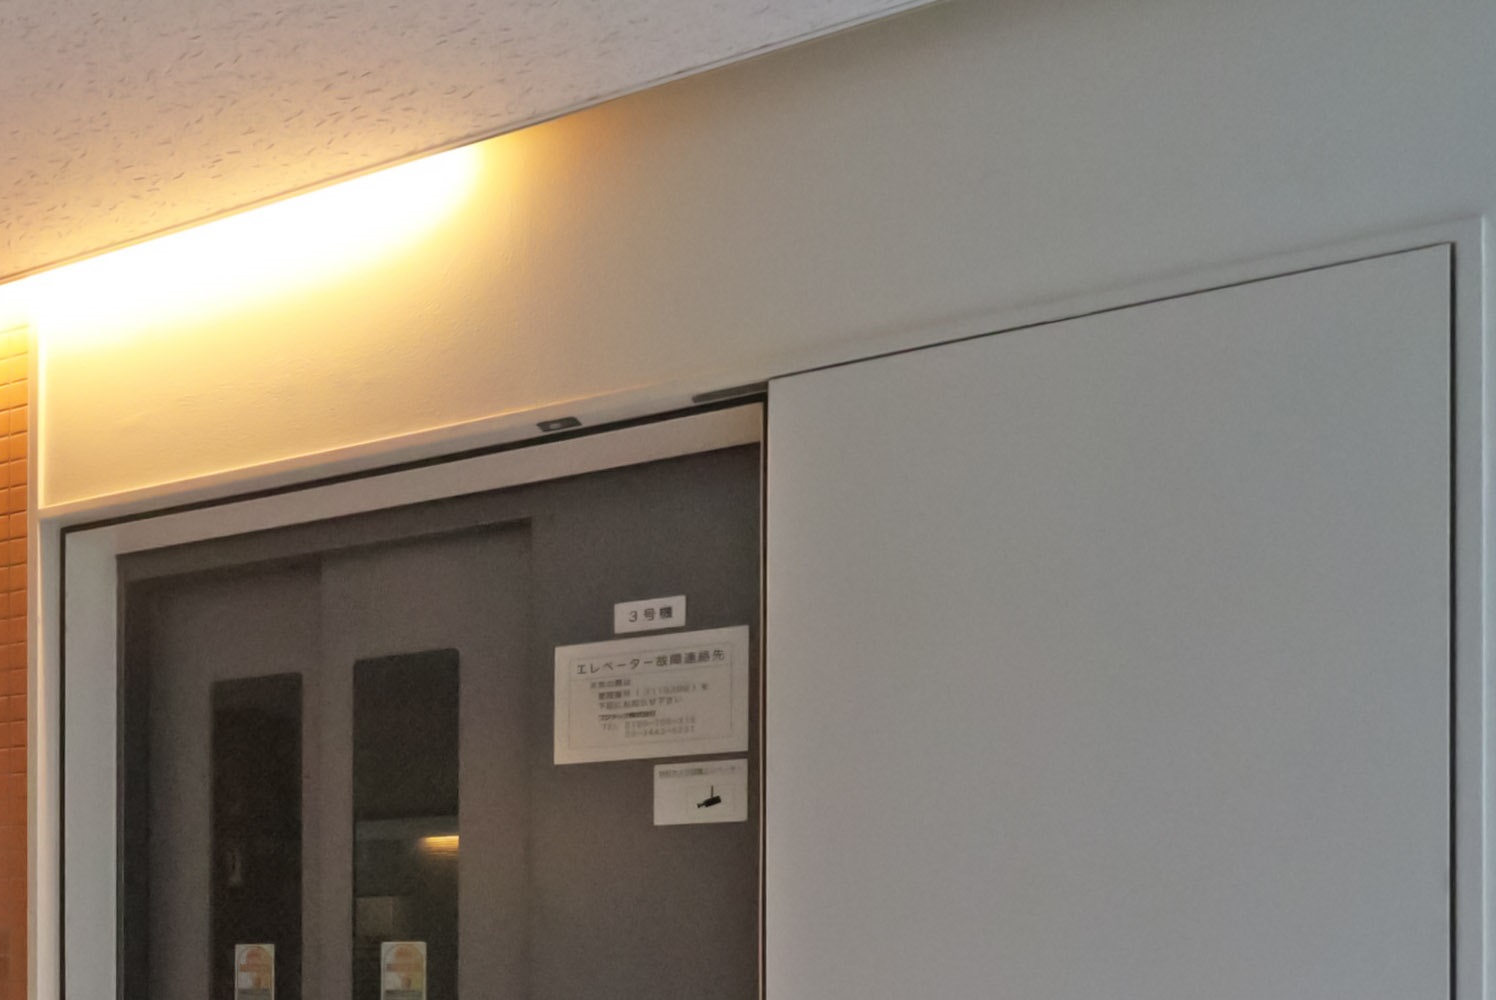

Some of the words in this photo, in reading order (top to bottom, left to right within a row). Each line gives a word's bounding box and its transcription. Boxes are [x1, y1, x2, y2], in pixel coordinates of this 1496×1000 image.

[628, 606, 673, 623] 3号機
[576, 649, 725, 674] エレベーター故障連絡先
